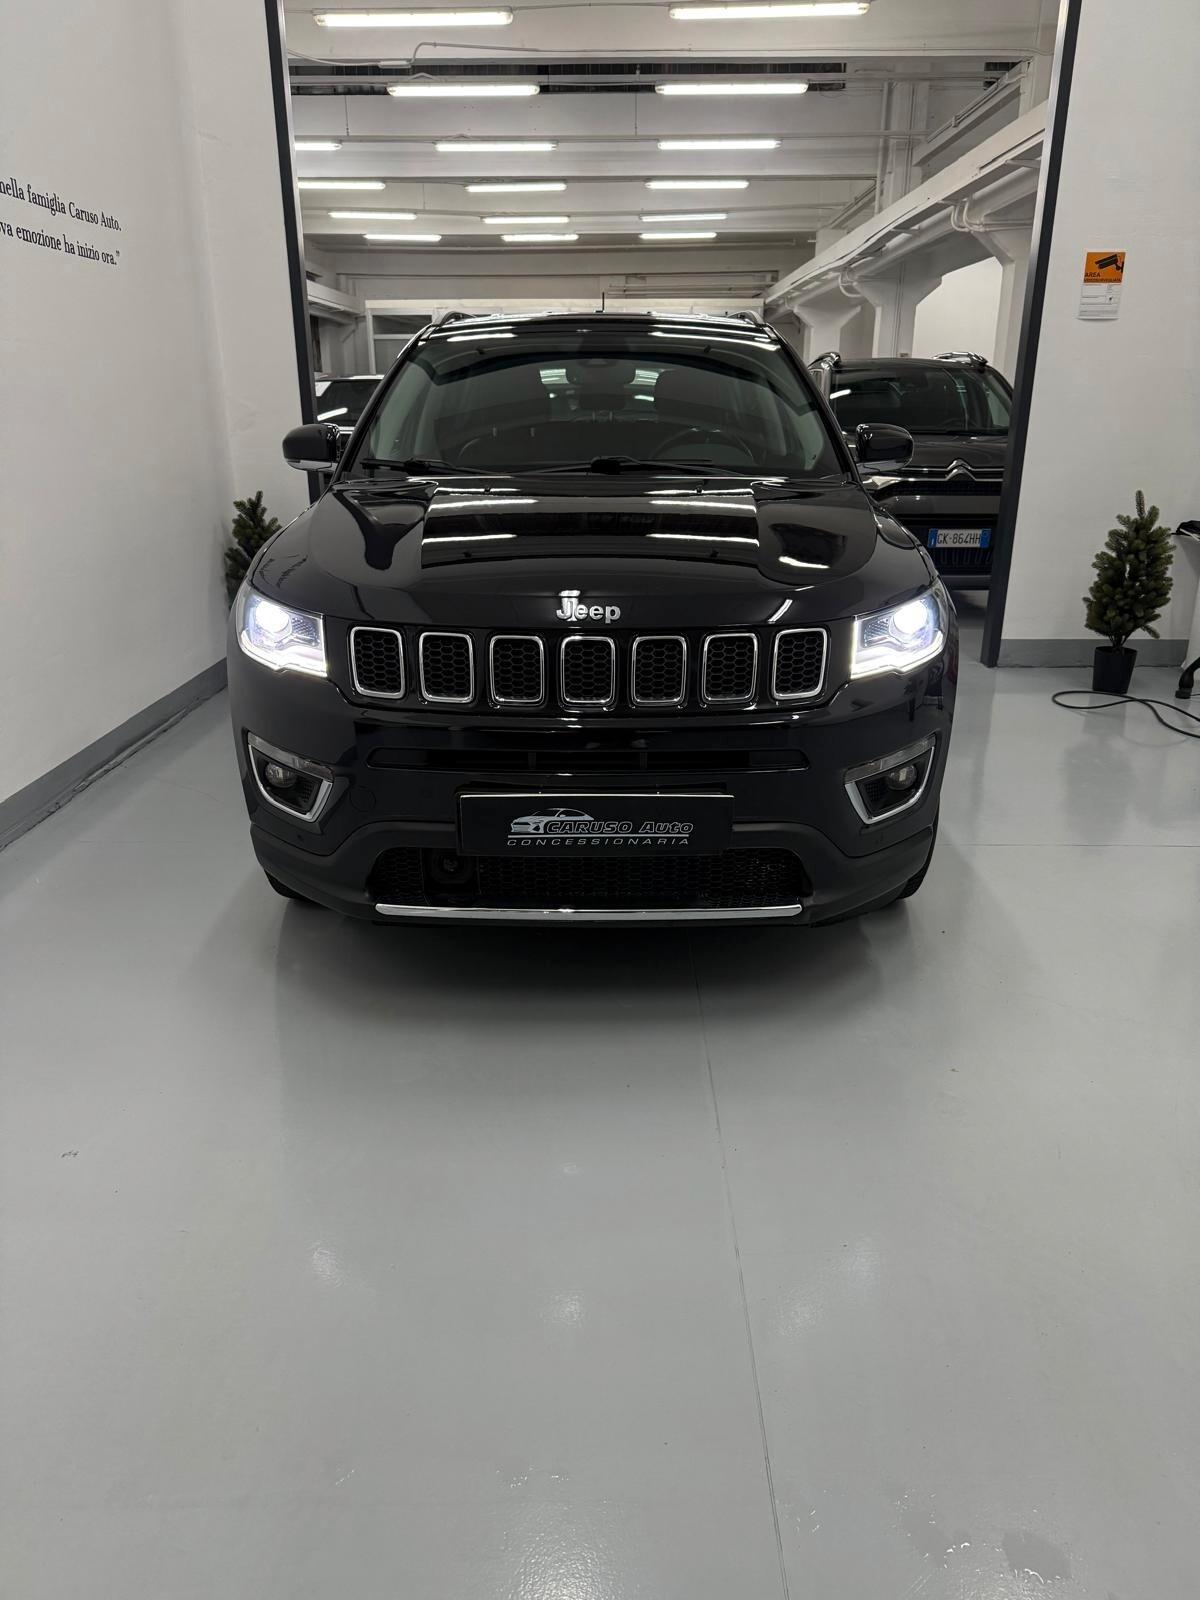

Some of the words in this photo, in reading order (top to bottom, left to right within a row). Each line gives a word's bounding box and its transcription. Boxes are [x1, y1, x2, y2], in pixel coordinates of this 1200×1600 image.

[0, 177, 25, 200] nella
[27, 184, 66, 216] famiglia
[68, 202, 99, 224] Caruso
[100, 211, 122, 231] Auto.
[0, 221, 14, 237] va
[16, 226, 62, 251] emozione
[63, 234, 76, 255] ha
[77, 241, 100, 261] inizio
[556, 597, 621, 624] Jeep
[546, 821, 633, 834] CARUSO
[638, 821, 694, 834] Auto
[507, 838, 689, 846] CONCESSIONARIA
